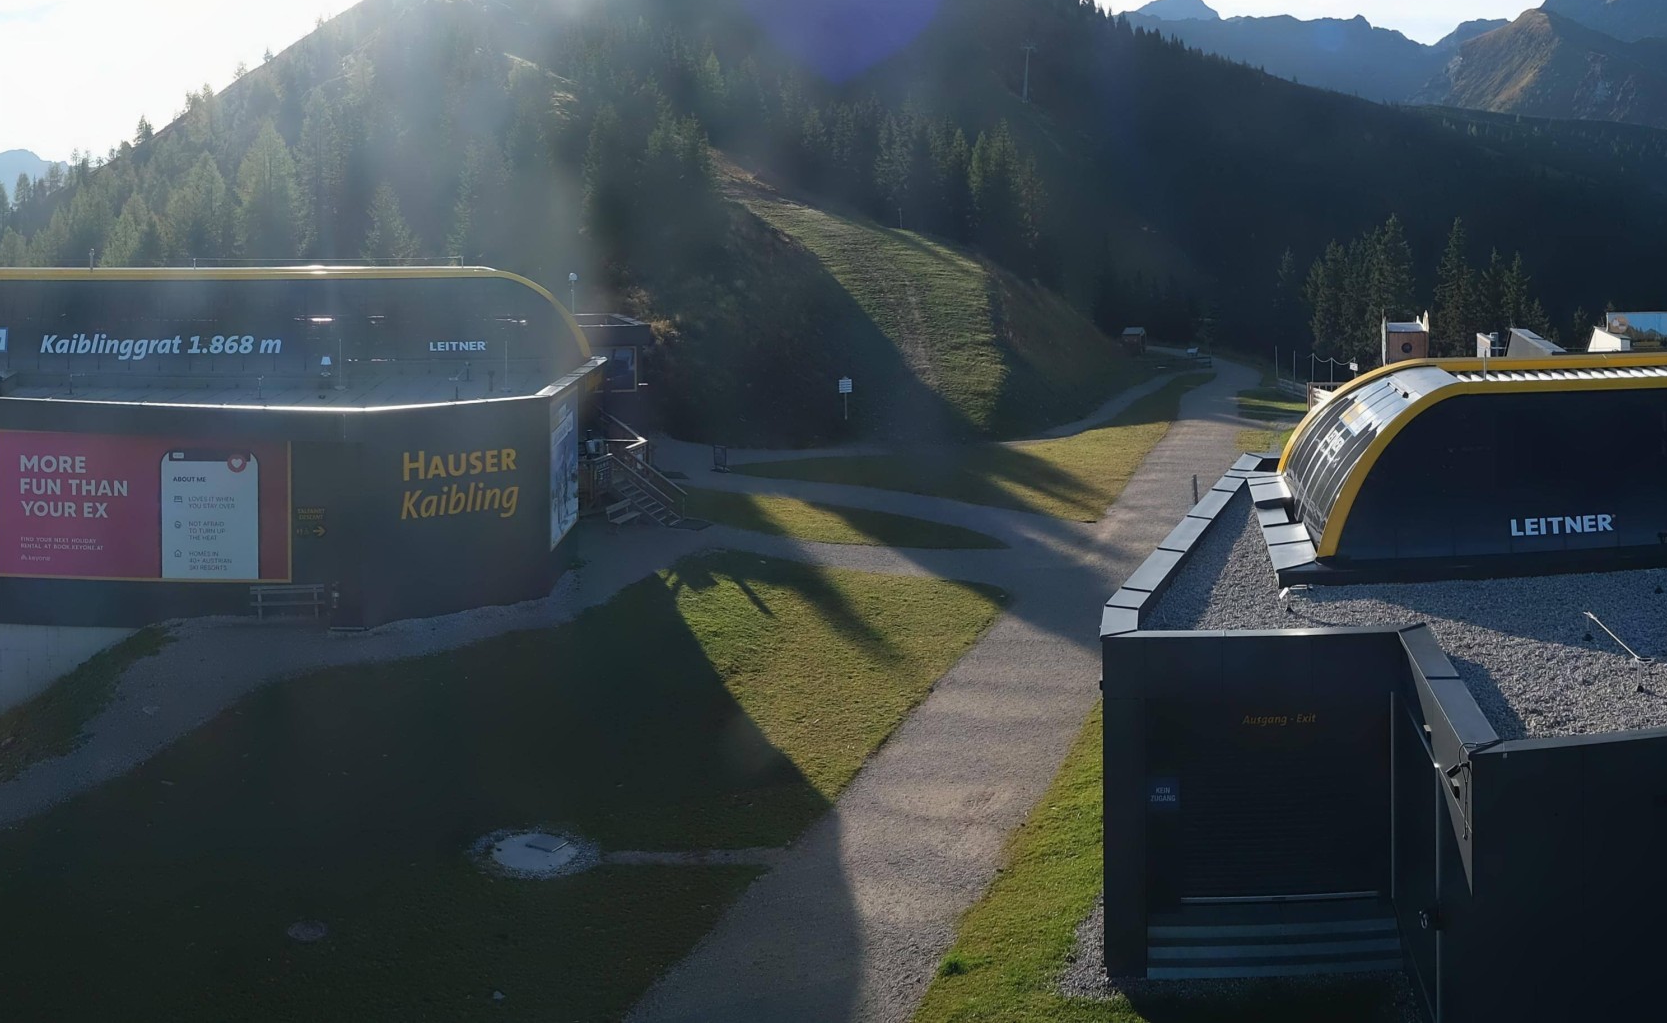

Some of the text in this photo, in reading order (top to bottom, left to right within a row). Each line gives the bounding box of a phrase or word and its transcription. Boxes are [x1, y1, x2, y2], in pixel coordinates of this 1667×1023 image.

[40, 333, 282, 360] Kaiblinggrat 1.868 m
[429, 341, 487, 352] LEITNER
[20, 455, 87, 473] MORE
[403, 448, 517, 481] HAUSER
[20, 478, 128, 497] FUN THAN
[21, 500, 109, 518] YOUR EX
[401, 482, 519, 519] Kaibling
[1510, 514, 1614, 537] LEITNER
[1241, 714, 1288, 727] Ausgang
[1296, 713, 1317, 723] Exit
[1150, 794, 1176, 802] ZUGANG
[1155, 786, 1171, 794] KEIN
